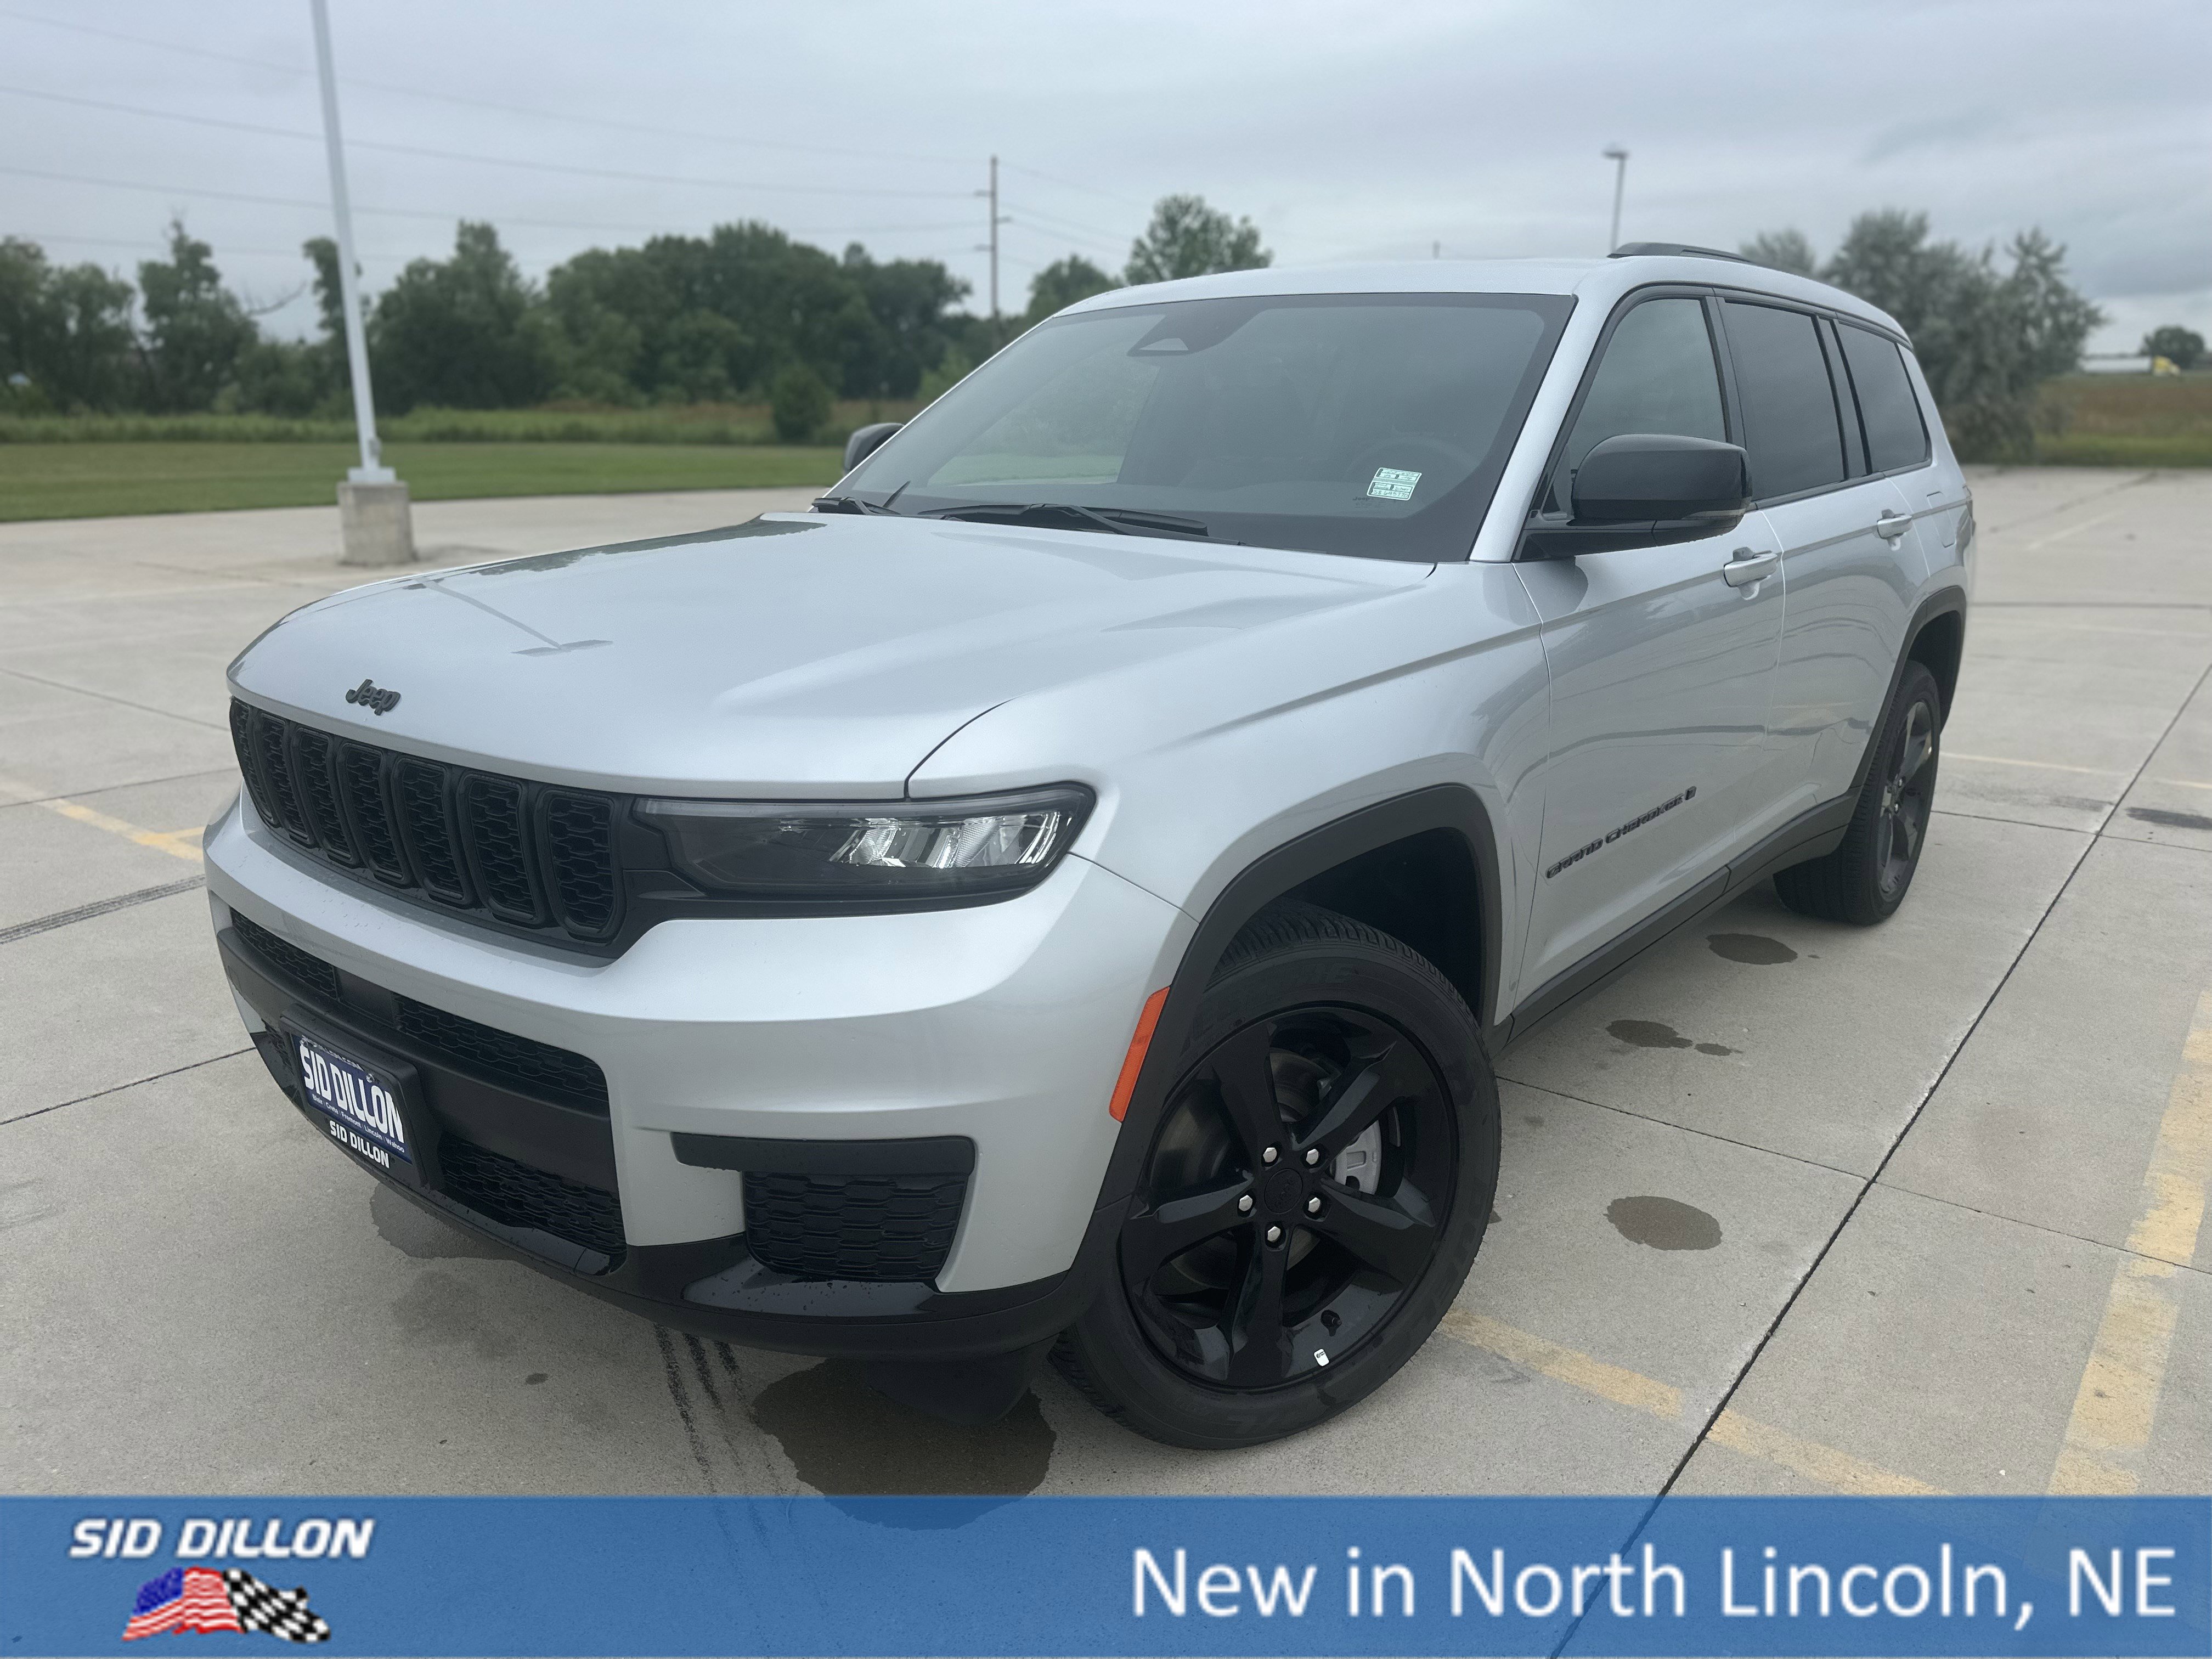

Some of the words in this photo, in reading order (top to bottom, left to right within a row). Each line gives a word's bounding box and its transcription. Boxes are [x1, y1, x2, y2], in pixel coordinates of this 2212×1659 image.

[345, 679, 401, 716] Jeep
[1545, 838, 1604, 879] GRAND
[1605, 793, 1684, 844] CHEROKEE
[300, 1043, 332, 1102] SID
[330, 1063, 405, 1144] DILLON
[326, 1102, 338, 1115] Crete
[341, 1111, 362, 1128] Fremont
[385, 1137, 405, 1153] Wahoo
[330, 1120, 348, 1143] SID
[349, 1132, 390, 1169] DILLON
